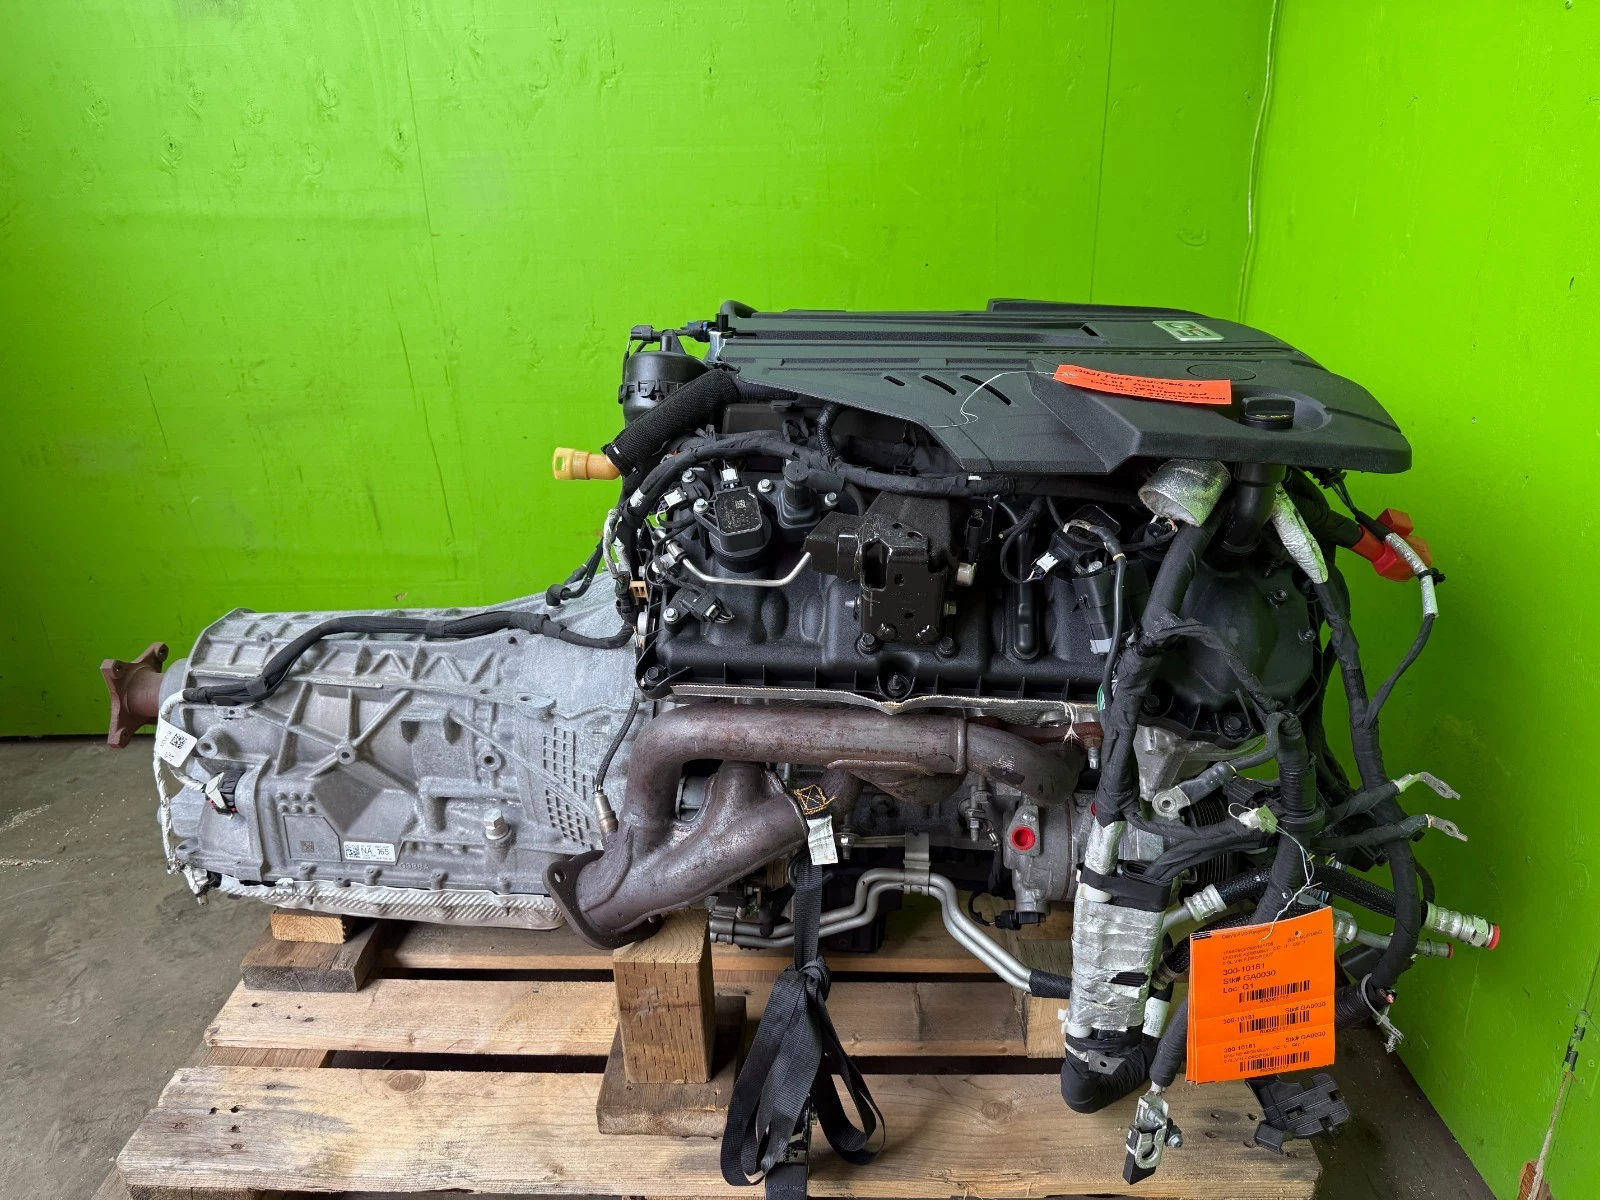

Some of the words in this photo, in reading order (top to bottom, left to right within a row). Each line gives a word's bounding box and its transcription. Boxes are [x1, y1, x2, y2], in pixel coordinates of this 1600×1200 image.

[1223, 963, 1265, 976] 300-10181
[1223, 976, 1241, 985] Stk#
[1243, 970, 1276, 981] GA0030
[1223, 986, 1240, 994] Loc:
[1223, 1014, 1255, 1024] 300-10181
[1300, 1001, 1326, 1011] GA0030
[1223, 1043, 1256, 1053] 300-10181
[1300, 1030, 1326, 1040] GA0030
